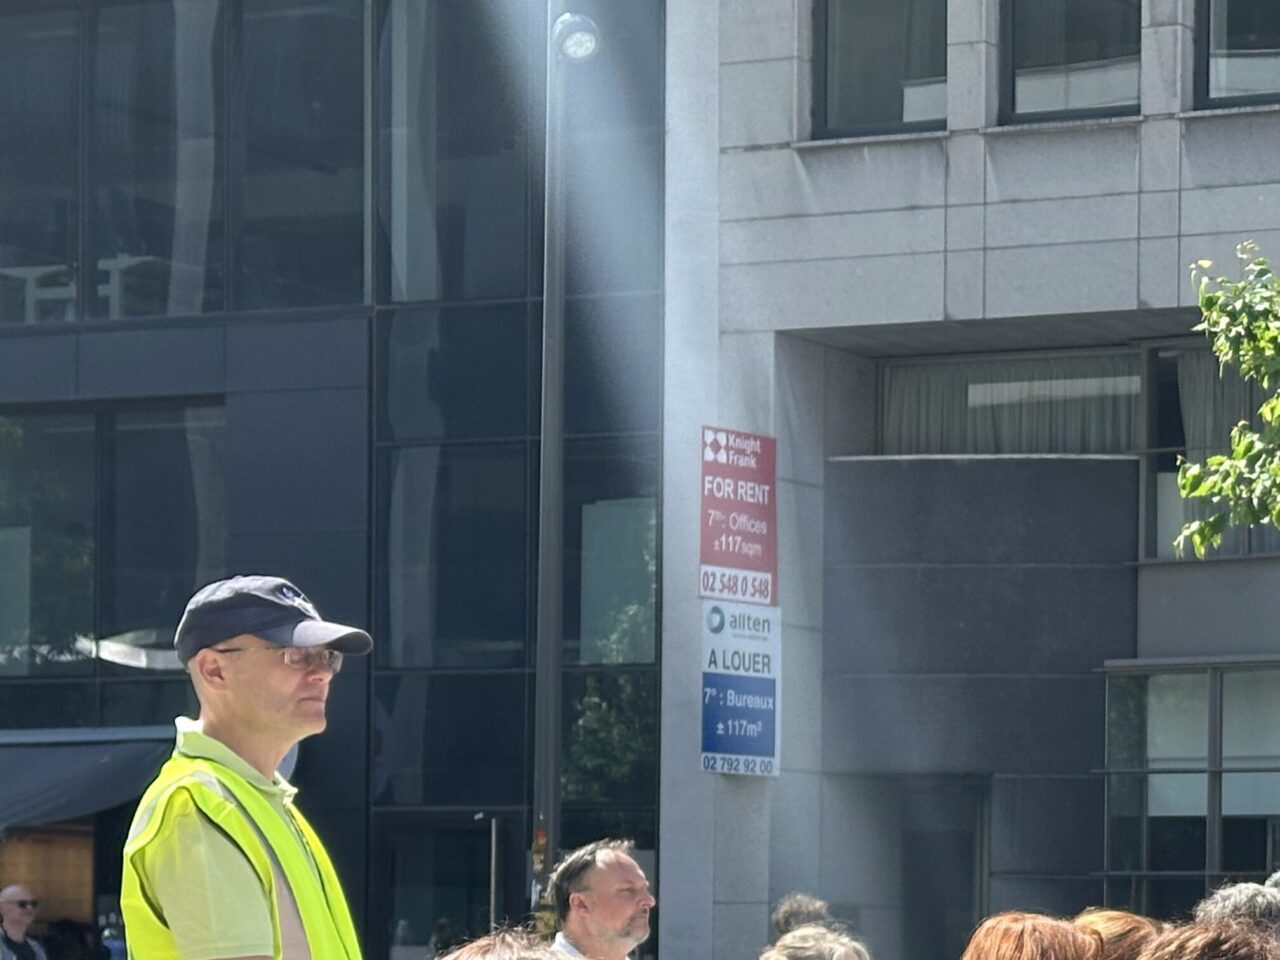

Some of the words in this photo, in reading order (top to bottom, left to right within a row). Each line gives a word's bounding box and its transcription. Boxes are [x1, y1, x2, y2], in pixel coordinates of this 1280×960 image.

[728, 432, 761, 454] Knight
[728, 450, 757, 469] Frank
[704, 475, 734, 499] FOR
[737, 480, 770, 505] RENT
[729, 511, 767, 535] Offices
[702, 570, 716, 592] 02
[719, 573, 738, 596] 548
[741, 576, 748, 597] 0
[750, 577, 769, 599] 548
[707, 648, 718, 669] A
[722, 649, 771, 674] LOUER
[727, 689, 774, 711] Bureaux
[703, 755, 716, 771] 02
[720, 756, 740, 773] 792
[743, 758, 757, 774] 92
[760, 760, 773, 775] 00
